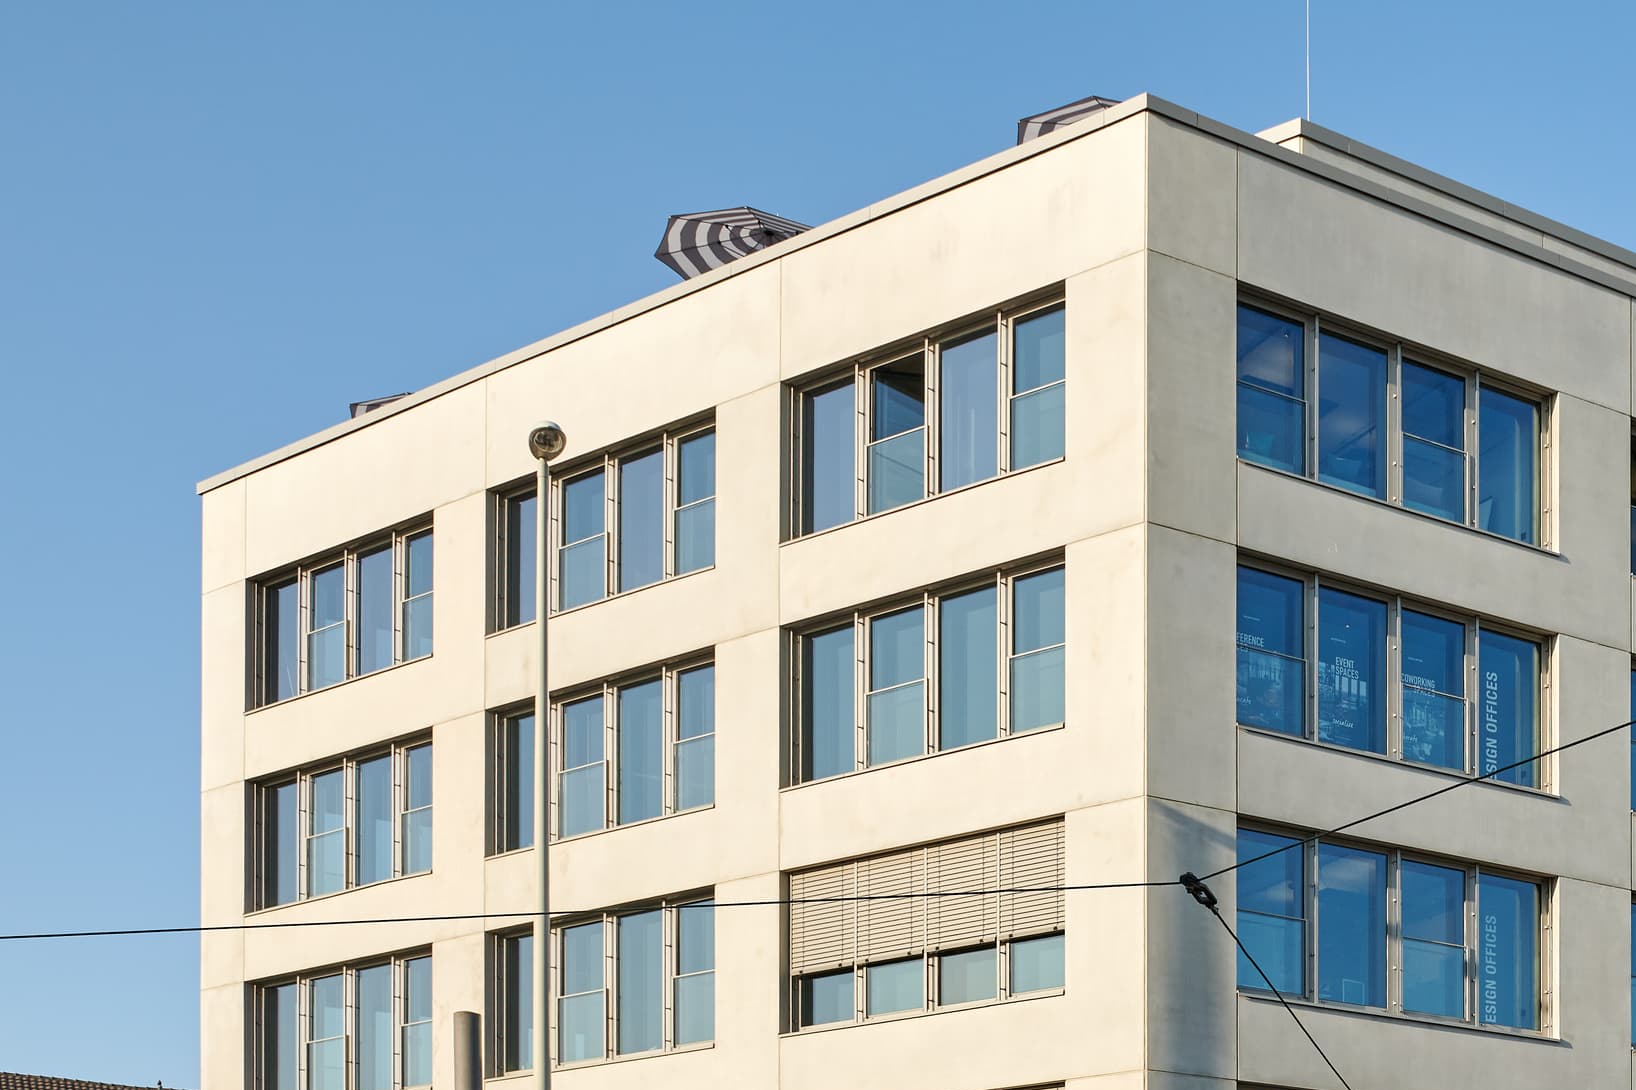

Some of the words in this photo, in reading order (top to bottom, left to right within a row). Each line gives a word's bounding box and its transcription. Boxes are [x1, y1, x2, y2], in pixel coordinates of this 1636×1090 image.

[1335, 656, 1355, 669] EVENT
[1335, 666, 1359, 680] SPACES
[1486, 671, 1498, 733] OFFICES
[1485, 914, 1497, 975] OFFICES
